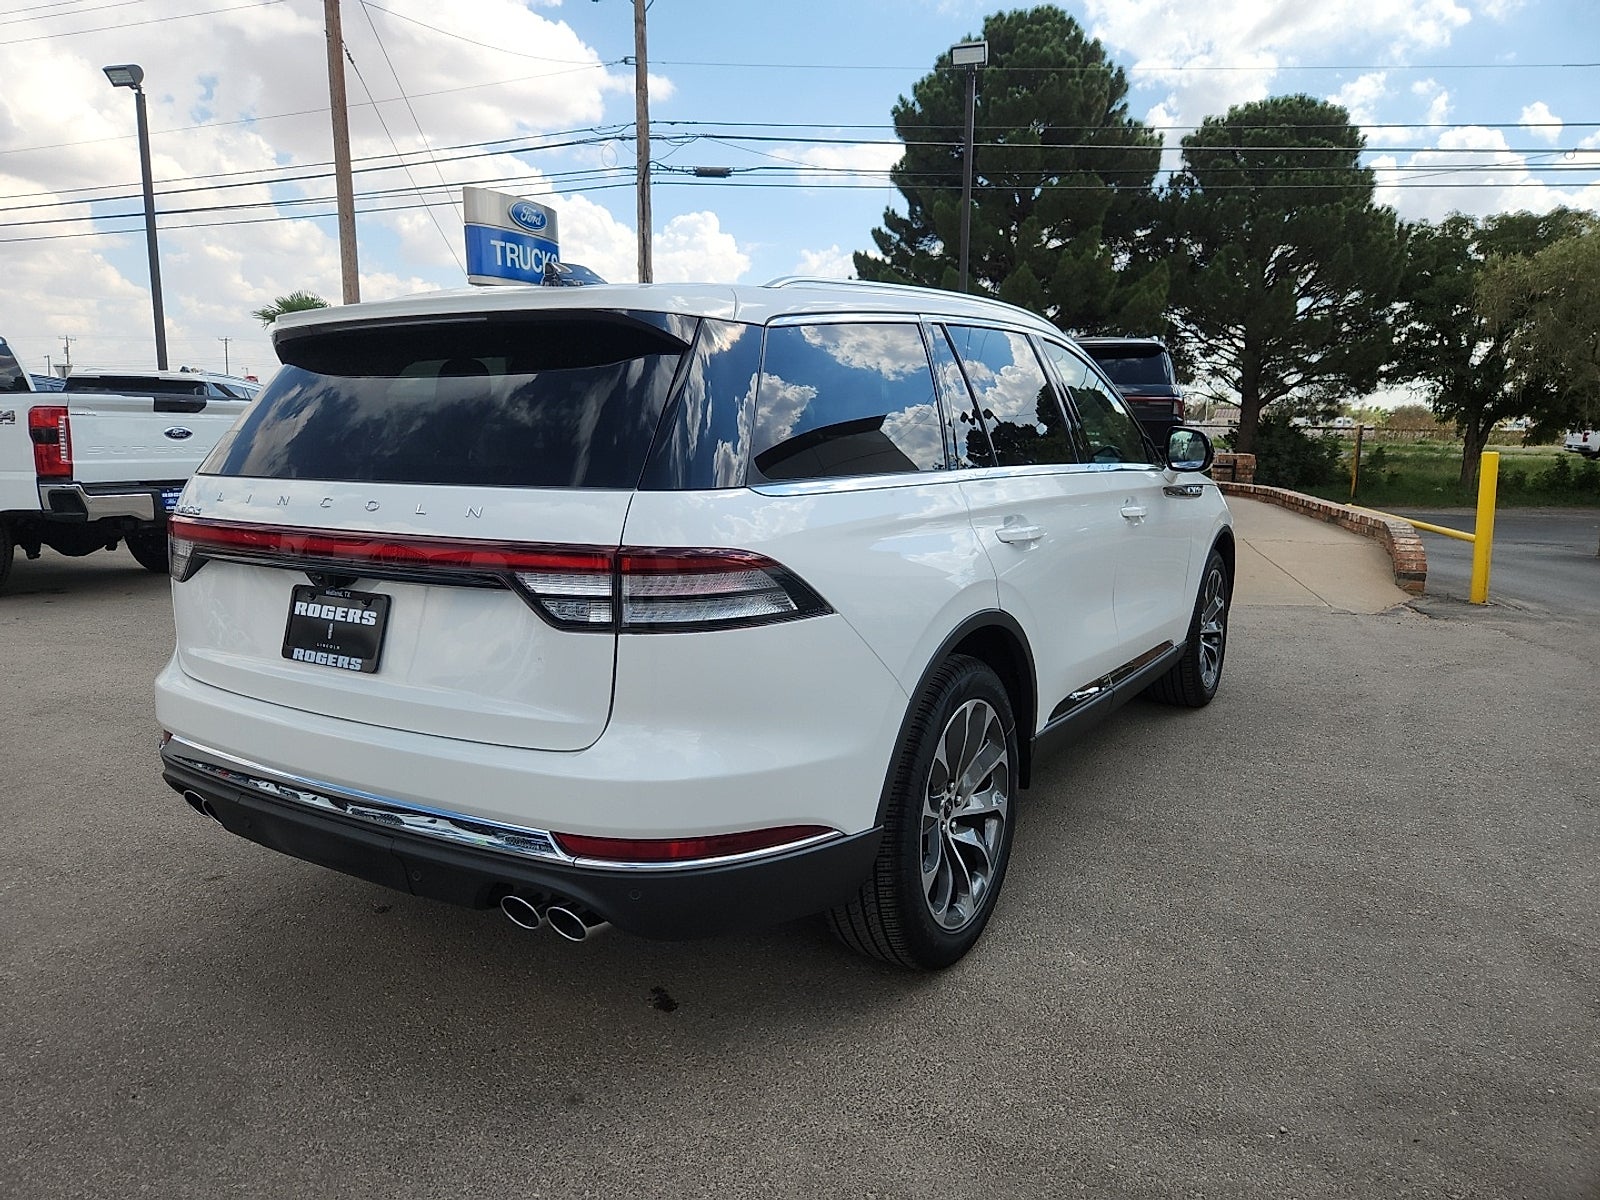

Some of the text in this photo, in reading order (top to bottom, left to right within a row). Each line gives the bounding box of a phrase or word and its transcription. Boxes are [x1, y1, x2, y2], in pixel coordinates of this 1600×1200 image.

[520, 205, 543, 226] Ford
[216, 491, 484, 519] LINCOLN
[294, 601, 378, 626] ROGERS
[292, 647, 363, 671] ROGERS
